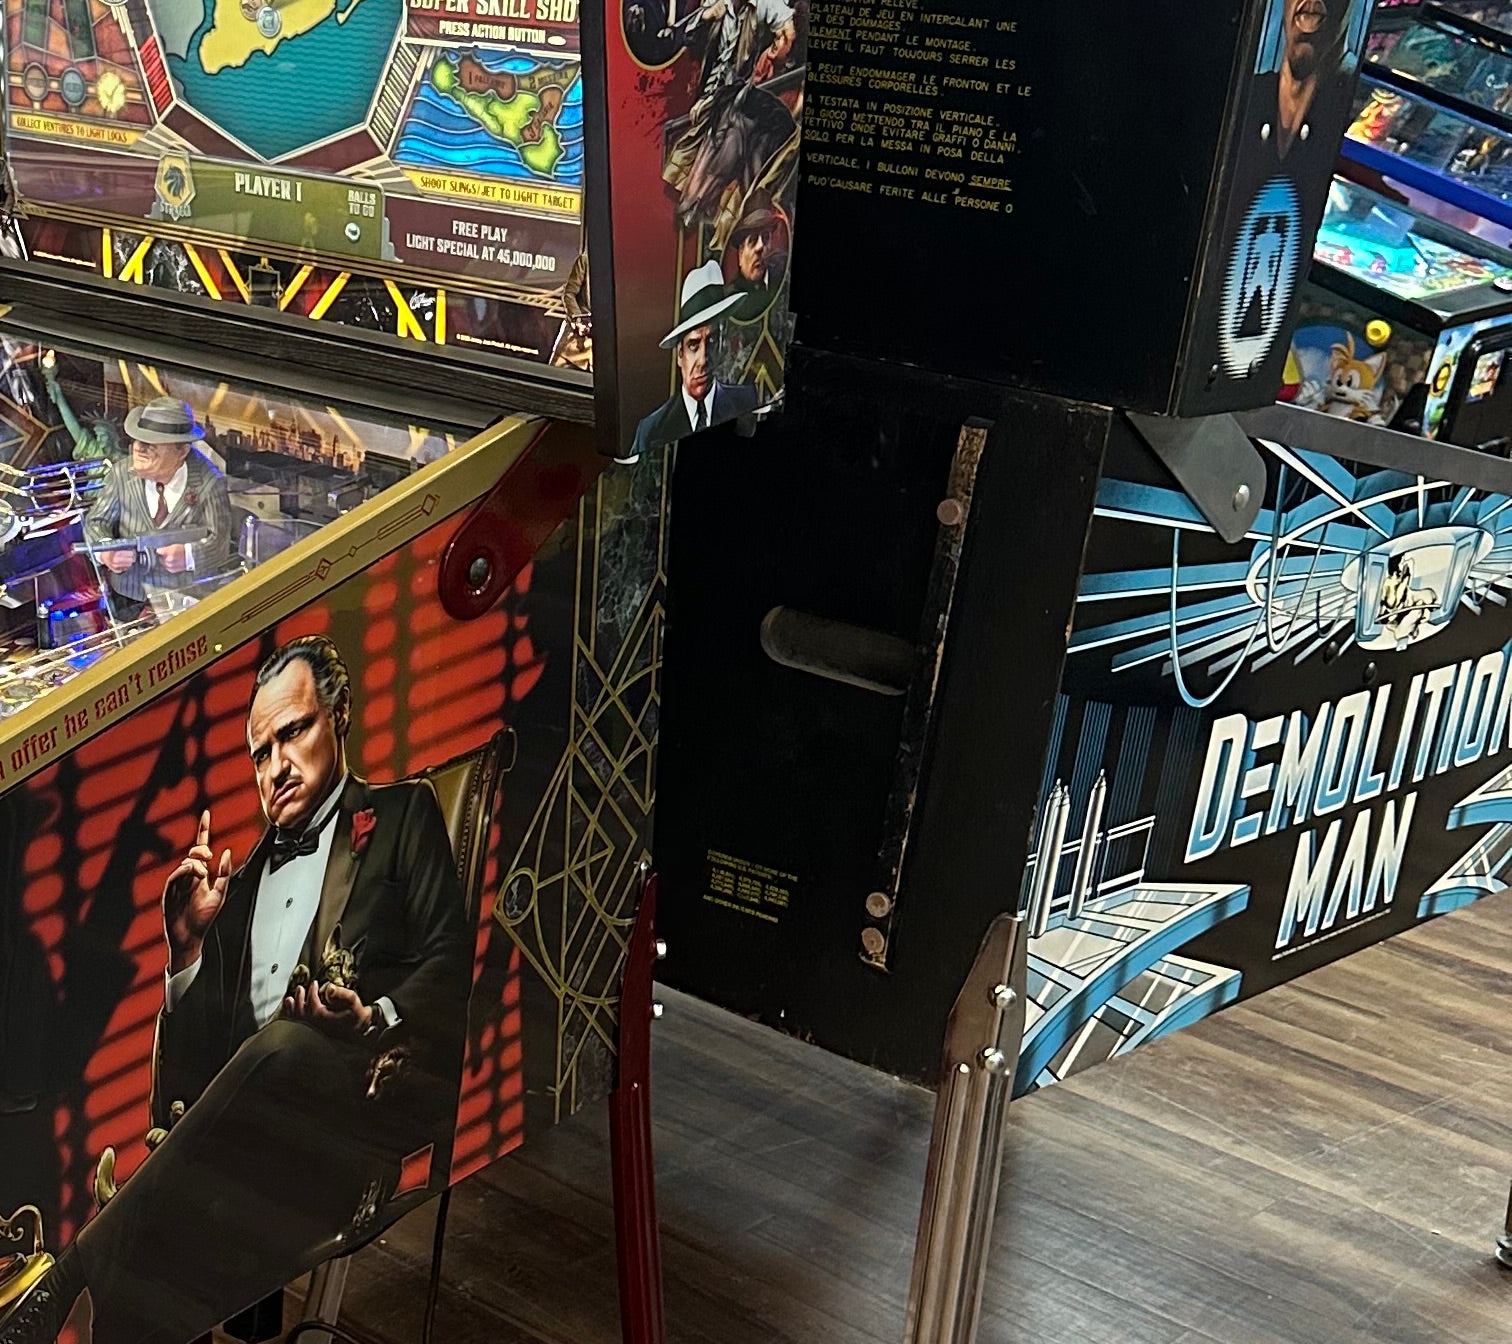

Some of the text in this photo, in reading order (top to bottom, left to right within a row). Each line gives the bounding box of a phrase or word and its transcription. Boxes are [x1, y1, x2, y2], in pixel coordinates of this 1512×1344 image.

[439, 19, 547, 44] PRESS ACTION BUTTON
[16, 116, 128, 143] COLLECT VENTURES TO LIGHT LOCKS
[234, 172, 303, 202] PLAYER 1
[877, 161, 919, 177] BULLONI
[924, 168, 966, 183] DEVONO
[968, 174, 1013, 192] SEMPRE
[347, 188, 377, 205] BALLS
[420, 176, 447, 191] SHOOT
[500, 186, 511, 200] TO
[513, 188, 539, 205] LIGHT
[542, 193, 574, 210] TARGET
[348, 203, 360, 215] TO
[452, 220, 508, 243] FREE PLAY
[406, 232, 556, 273] LIGHT SPECIAL AT 45,000,000
[10, 726, 61, 775] offer
[64, 704, 90, 739] he
[94, 667, 145, 718] can't
[147, 634, 209, 689] refuse
[1275, 791, 1418, 949] MAN
